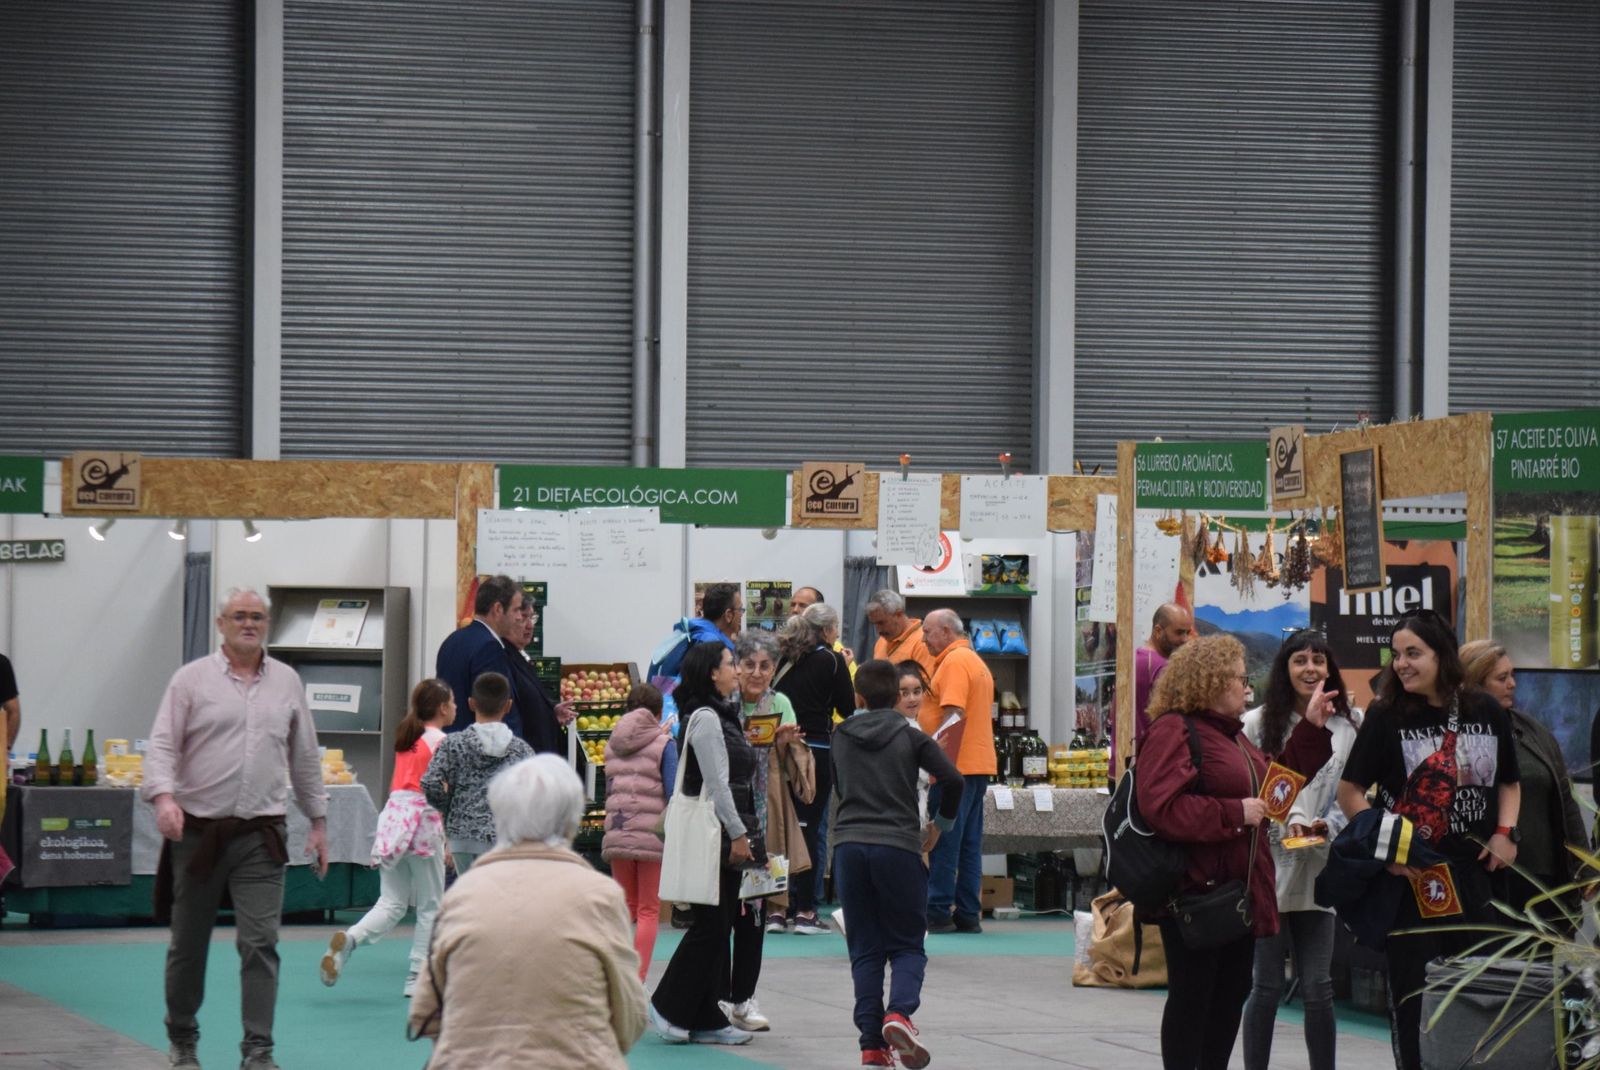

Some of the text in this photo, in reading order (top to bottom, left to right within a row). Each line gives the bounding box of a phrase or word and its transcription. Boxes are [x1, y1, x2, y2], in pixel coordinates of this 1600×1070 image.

[1497, 427, 1598, 449] 57 ACEITE DE OLIVA
[1137, 450, 1235, 473] 56 LURREKO AROMÁTICAS,
[1511, 453, 1580, 479] PINTARRÉ BIO
[513, 485, 738, 505] 21 DIETAECOLÓGICA.COM
[1137, 480, 1263, 498] PERMACULTURA Y BIODIVERSIDAD
[1339, 575, 1433, 616] miel
[1356, 636, 1375, 644] MIEL
[1398, 726, 1436, 741] TAKE
[1463, 723, 1483, 735] TO
